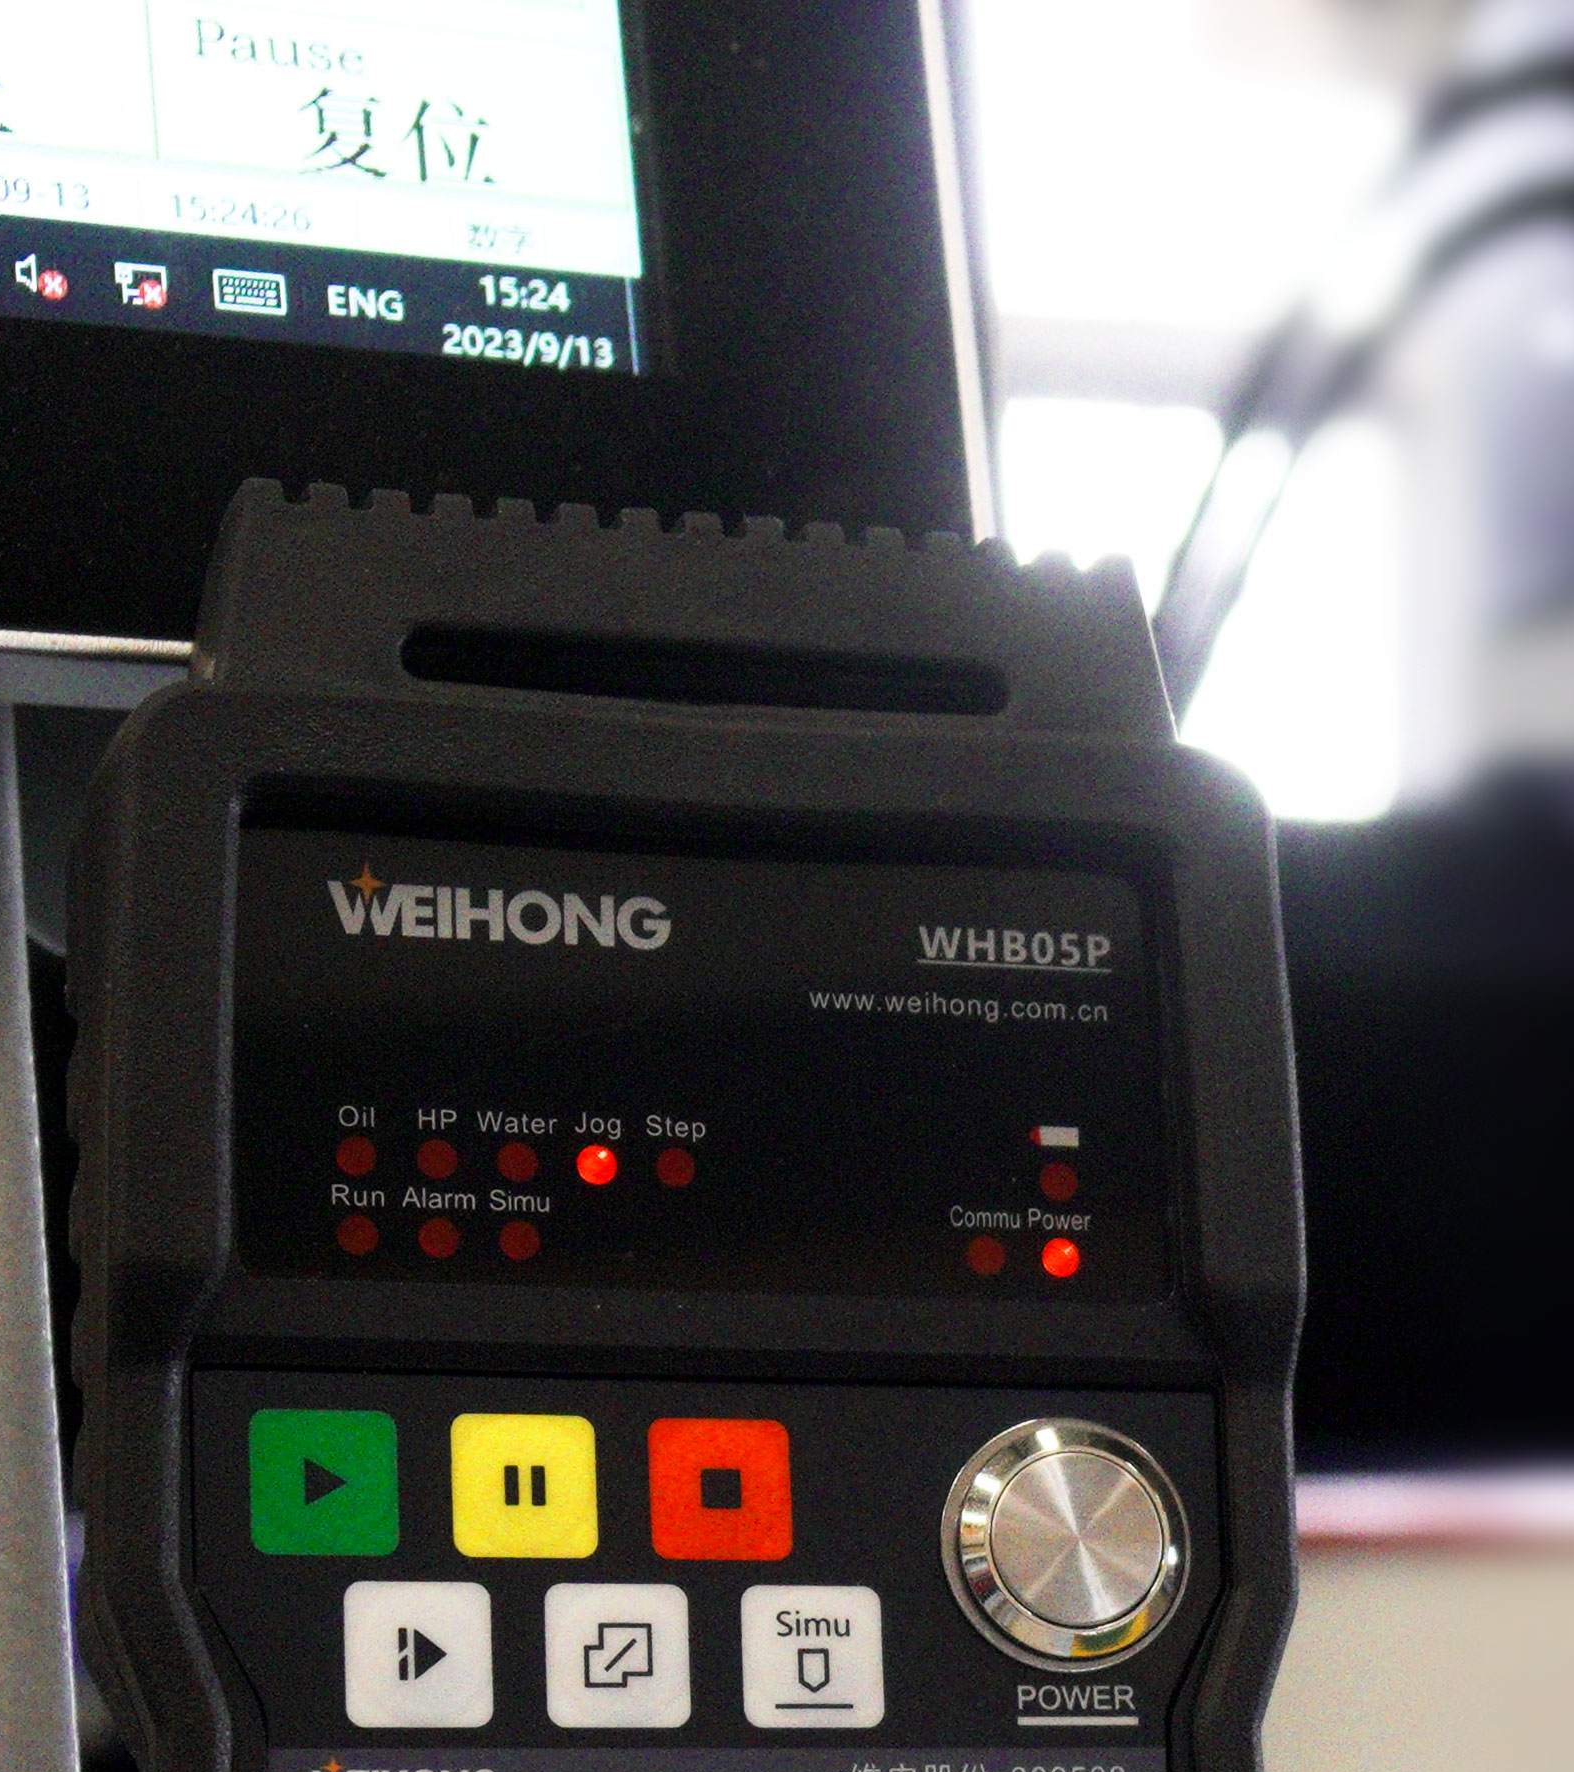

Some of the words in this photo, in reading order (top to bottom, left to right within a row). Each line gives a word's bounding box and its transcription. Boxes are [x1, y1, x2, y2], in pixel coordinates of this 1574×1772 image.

[191, 14, 369, 76] Pause
[297, 84, 499, 186] 复位
[327, 284, 405, 322] ENG
[477, 274, 573, 313] 15:24
[440, 321, 616, 370] 2023/9/13
[329, 881, 671, 951] WEIHONG
[919, 925, 1112, 967] WHB05P
[809, 991, 1109, 1024] www.weihong.com.cn
[337, 1104, 376, 1128] Oil
[417, 1108, 458, 1130] HP
[476, 1110, 558, 1135] Water
[574, 1112, 623, 1141] Jog
[645, 1113, 707, 1142] Step
[330, 1183, 386, 1208] Run
[401, 1186, 477, 1210] Alarm
[489, 1188, 551, 1214] Simu
[950, 1204, 1022, 1230] Commu
[1028, 1208, 1092, 1232] Power
[775, 1610, 852, 1639] Simu
[1016, 1684, 1137, 1712] POWER
